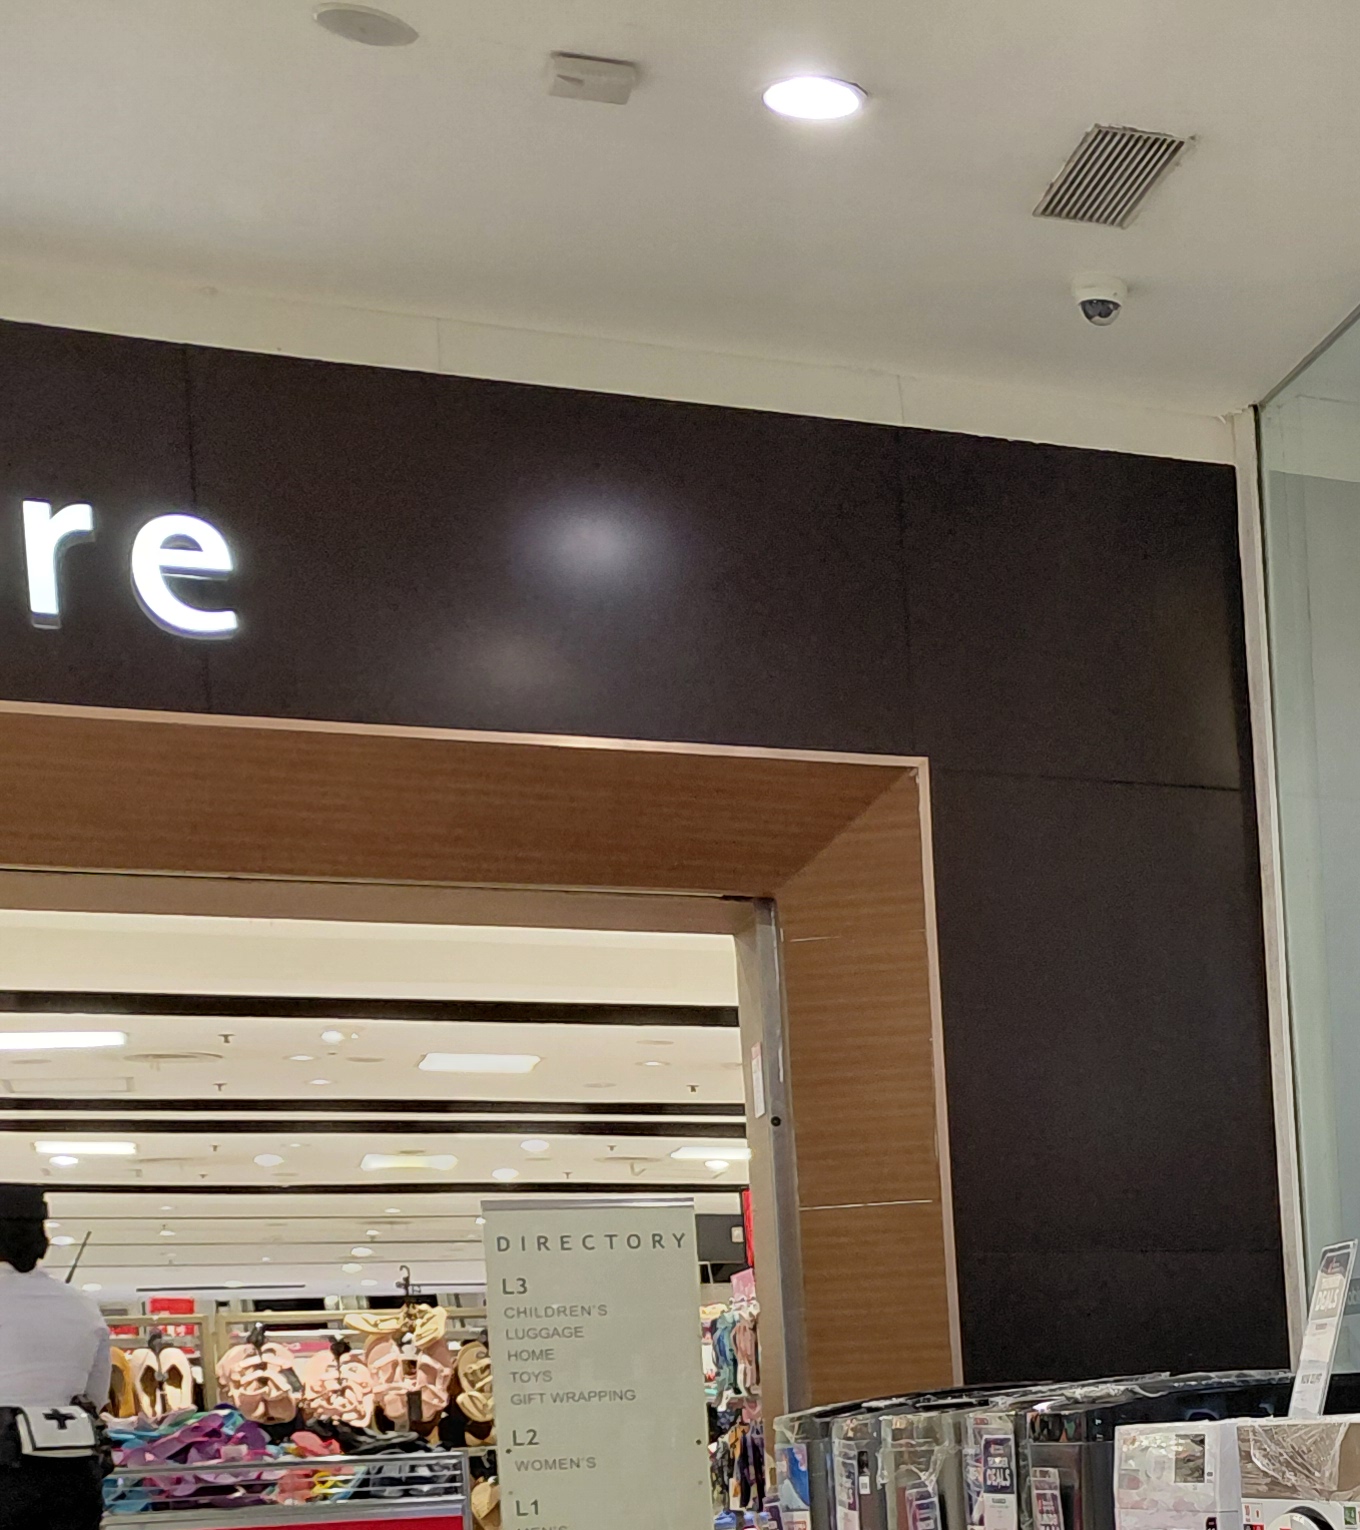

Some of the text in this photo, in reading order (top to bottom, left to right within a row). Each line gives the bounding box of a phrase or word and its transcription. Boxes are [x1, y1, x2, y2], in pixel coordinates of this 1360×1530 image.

[496, 1232, 686, 1252] DIRECTORY
[502, 1277, 529, 1296] L3
[503, 1304, 609, 1320] CHILDREN'S
[505, 1326, 585, 1341] LUGGAGE
[507, 1348, 556, 1363] HOME
[509, 1370, 554, 1384] TOYS
[510, 1388, 637, 1406] GIFT WRAPPING
[512, 1428, 540, 1447] L2
[514, 1456, 598, 1473] WOMEN'S
[515, 1499, 540, 1518] L1
